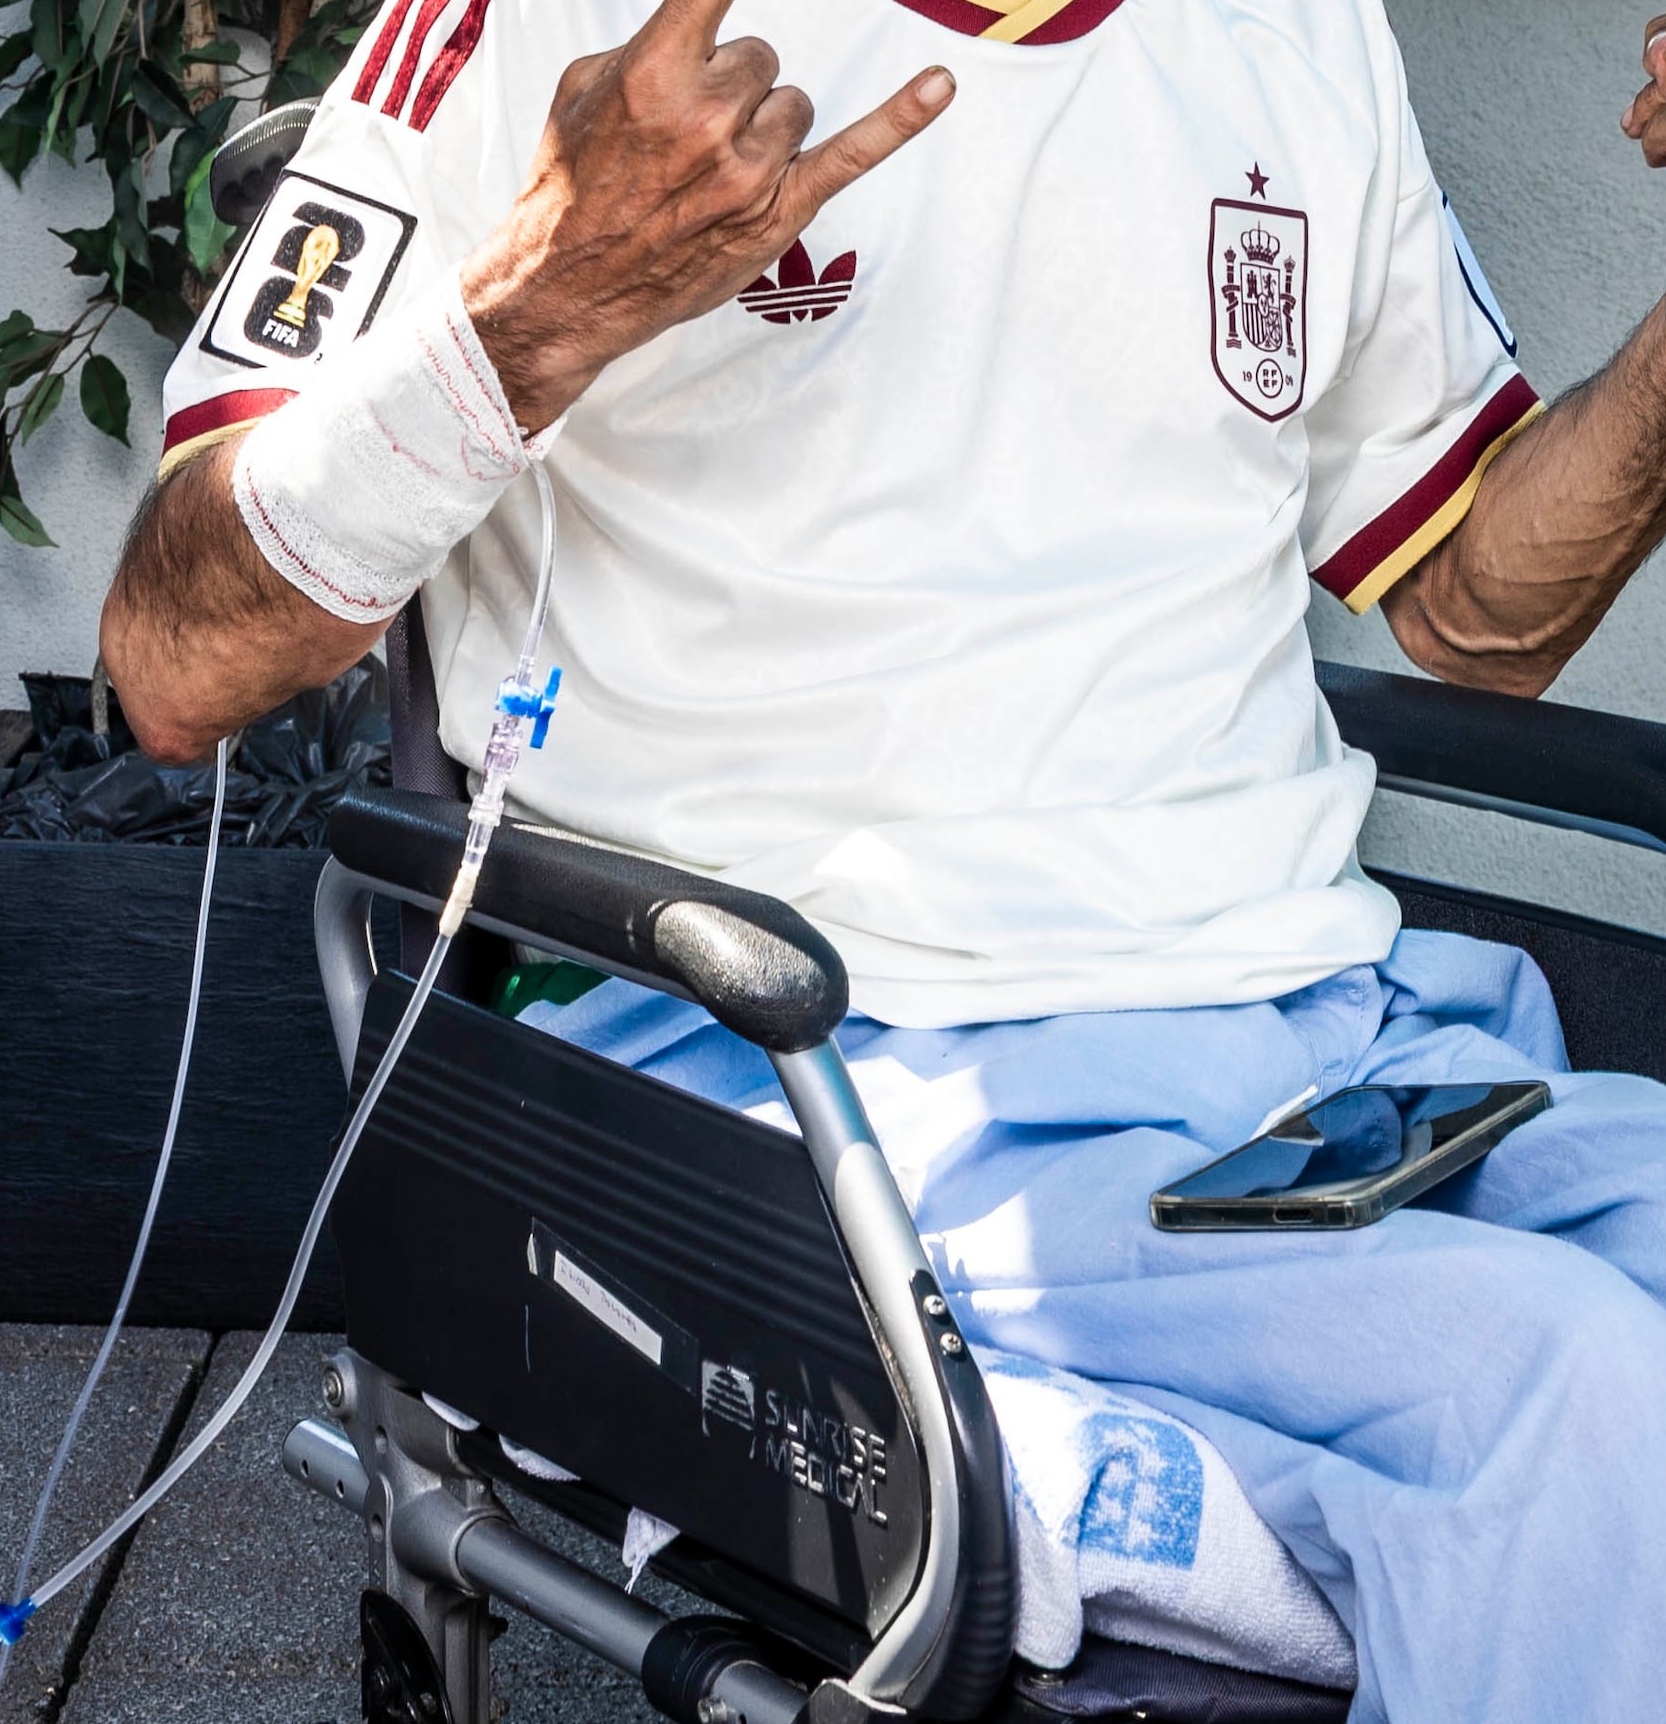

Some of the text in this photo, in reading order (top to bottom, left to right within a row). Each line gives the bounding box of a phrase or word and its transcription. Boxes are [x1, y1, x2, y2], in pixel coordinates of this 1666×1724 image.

[261, 318, 301, 348] FIFA
[1242, 370, 1253, 382] 19
[764, 1389, 887, 1477] SUNRISE
[765, 1432, 889, 1523] MEDICAL
